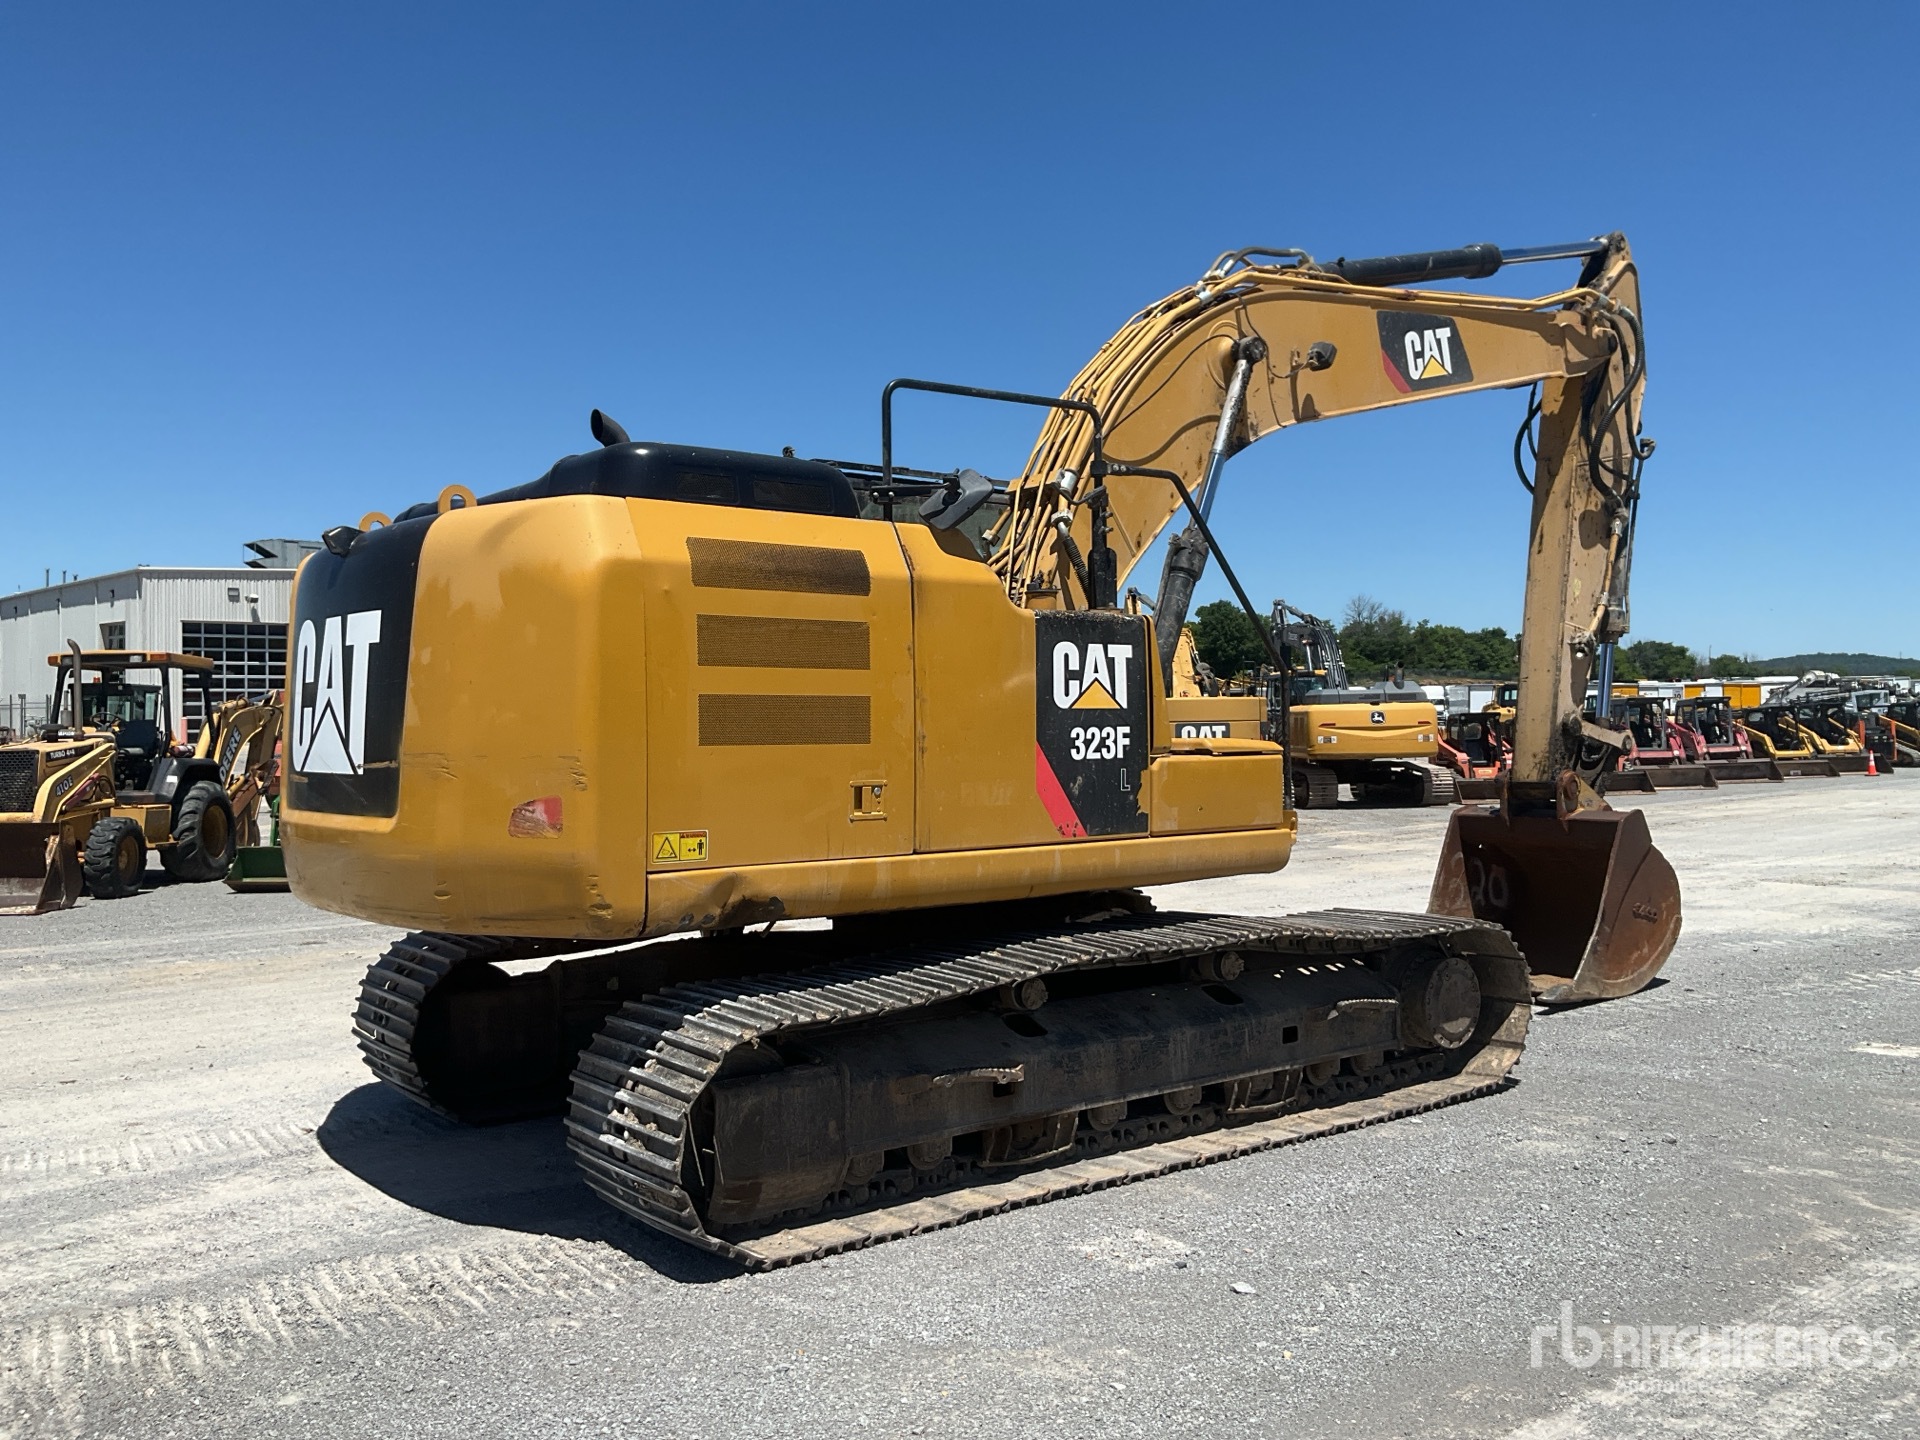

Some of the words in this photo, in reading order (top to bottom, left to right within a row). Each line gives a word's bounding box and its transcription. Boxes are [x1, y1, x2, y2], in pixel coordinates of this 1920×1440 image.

[1404, 327, 1452, 380] CAT
[292, 610, 382, 775] CAT
[1053, 641, 1133, 709] CAT
[50, 750, 66, 759] TURBO
[219, 726, 242, 783] DEERE
[1070, 726, 1131, 761] 323F
[56, 775, 74, 796] 410E
[1120, 768, 1131, 791] L
